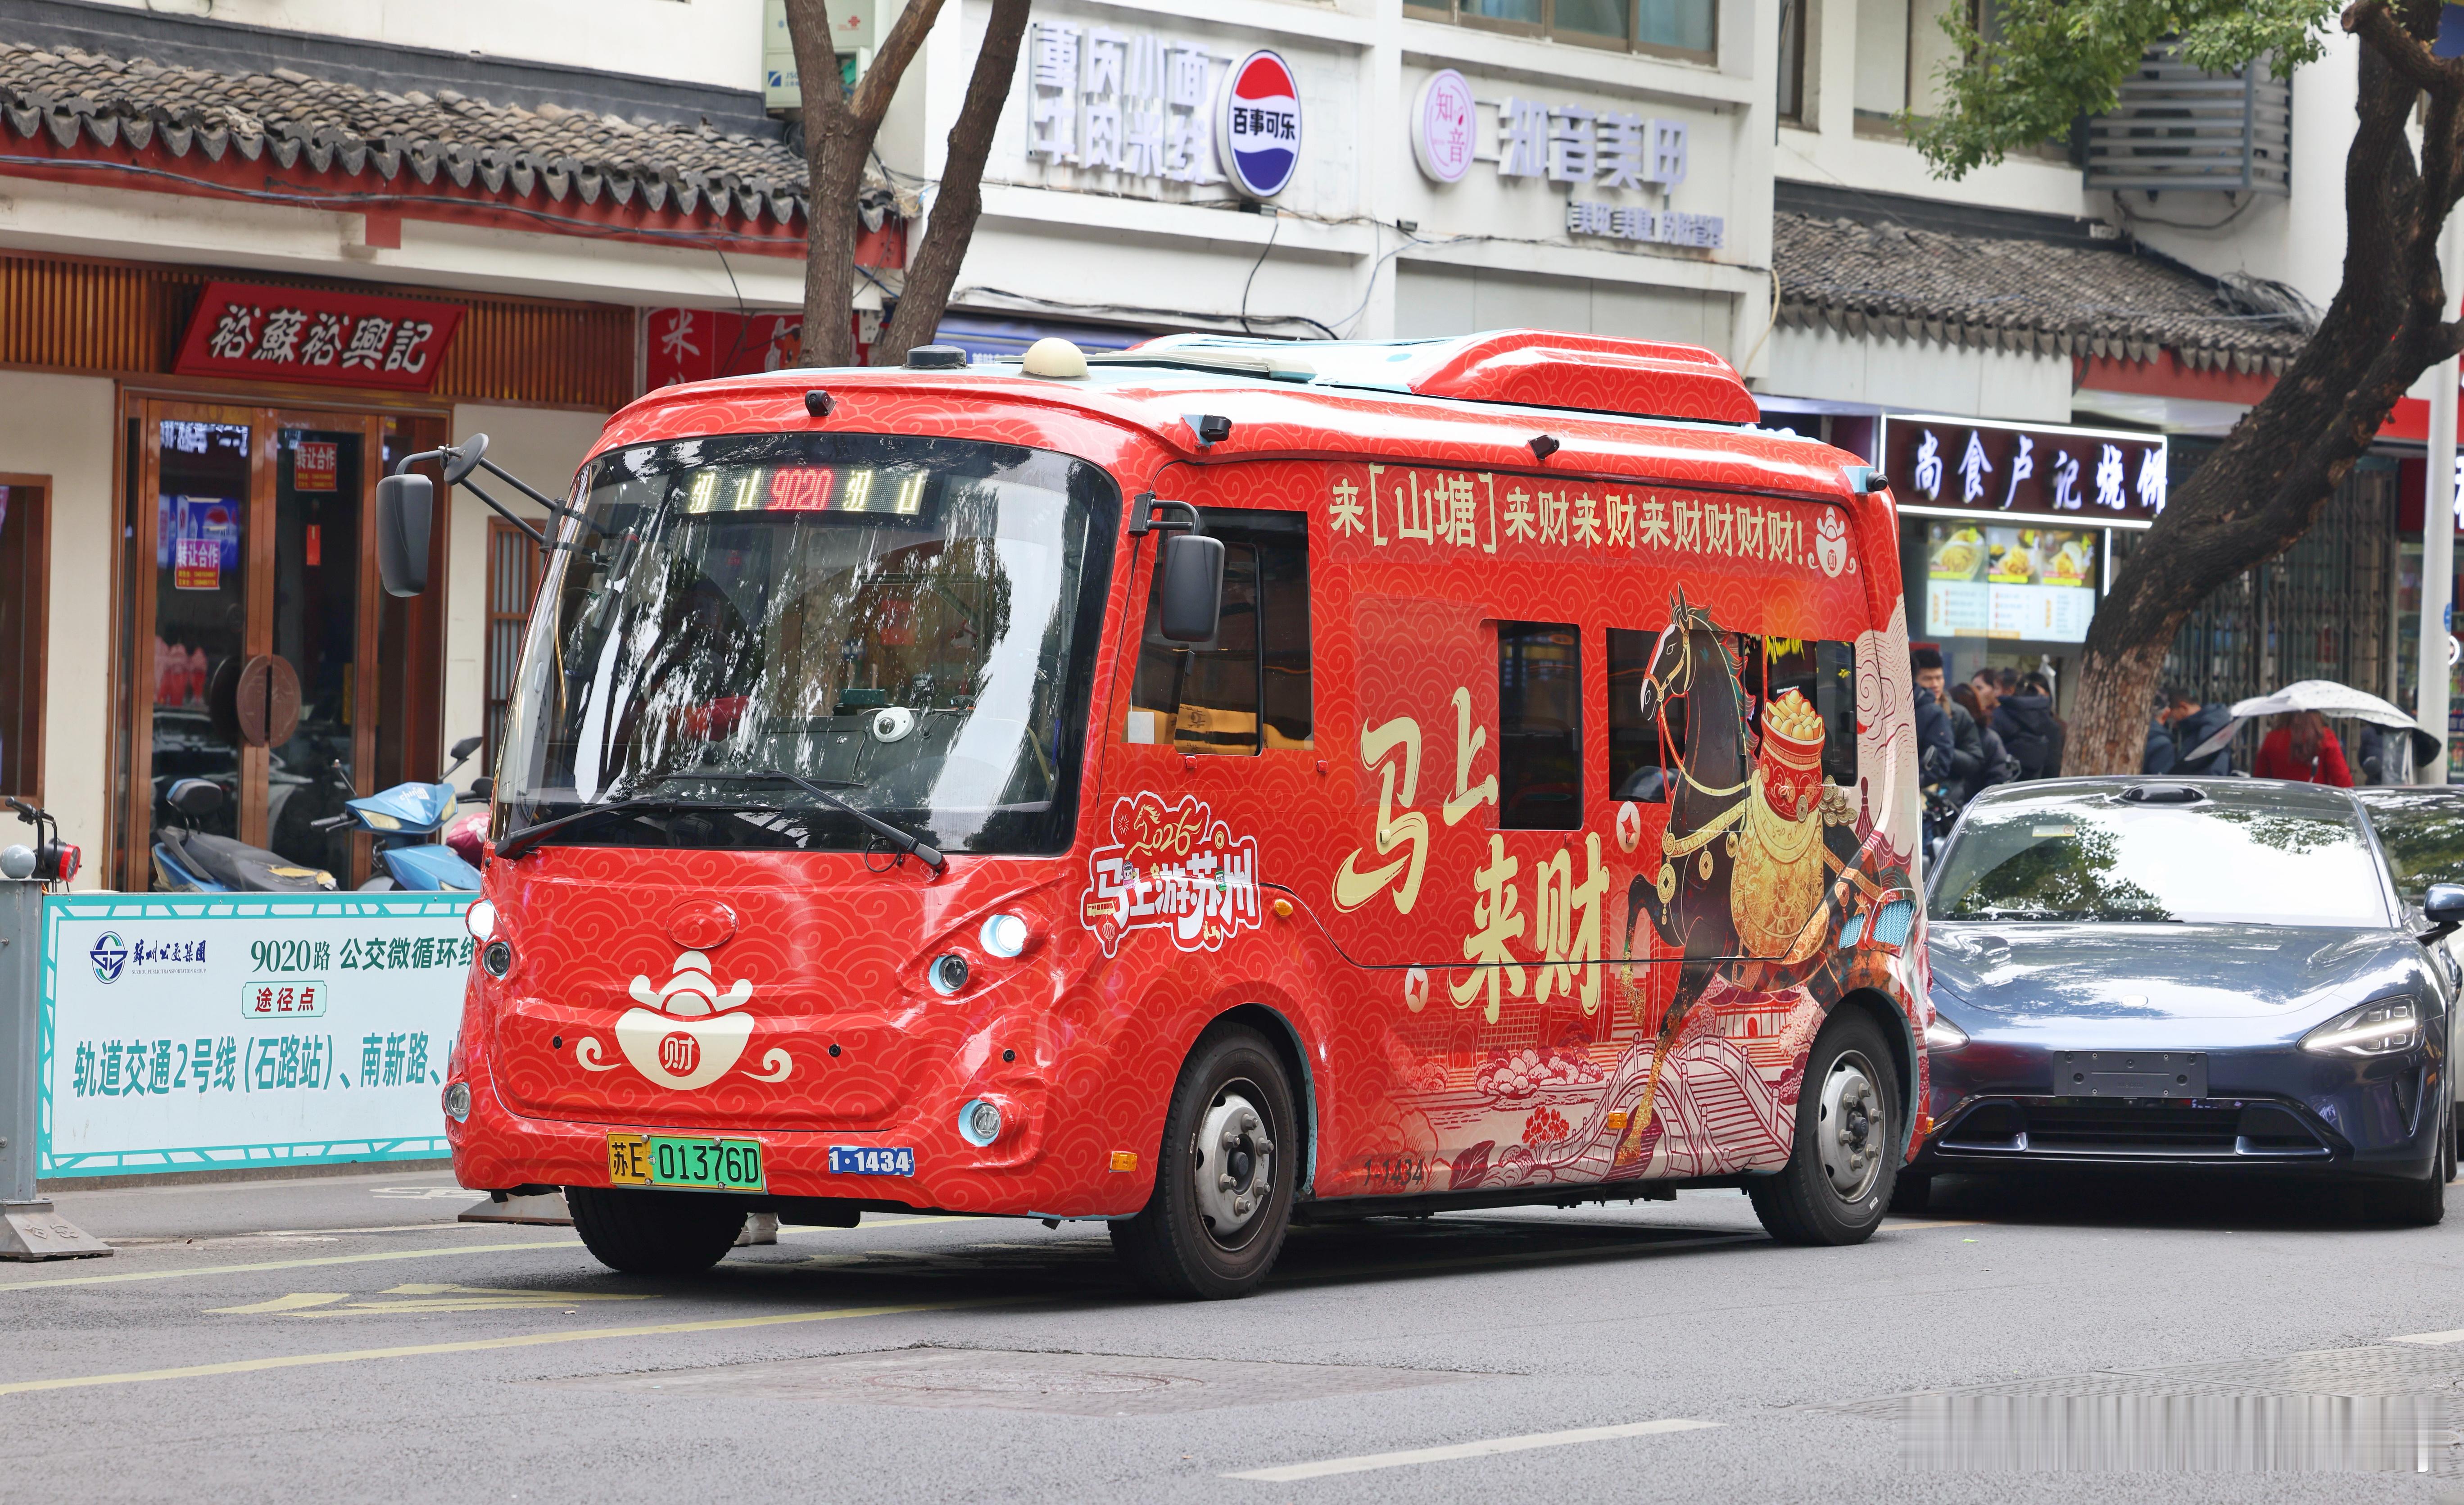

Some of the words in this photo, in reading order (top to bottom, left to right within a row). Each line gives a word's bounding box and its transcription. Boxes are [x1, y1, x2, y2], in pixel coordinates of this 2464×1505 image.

[1036, 97, 1208, 184] 牛肉米线
[1233, 107, 1296, 141] 百事可乐
[1500, 96, 1688, 195] 知音美甲
[765, 468, 834, 510] 9020
[1915, 429, 2168, 514] 尚食卢记烧饼
[1332, 686, 1499, 915] 马上
[1096, 848, 1255, 940] 马上游苏州
[1447, 832, 1610, 1024] 来财
[251, 939, 331, 973] 9020路
[255, 986, 315, 1013] 途径点
[73, 1030, 459, 1098] 轨道交通2号线（石路站）、南新路、
[664, 1037, 695, 1070] 财
[611, 1141, 648, 1178] 苏E
[658, 1143, 760, 1183] 01376D
[1364, 1158, 1423, 1186] 1-1434
